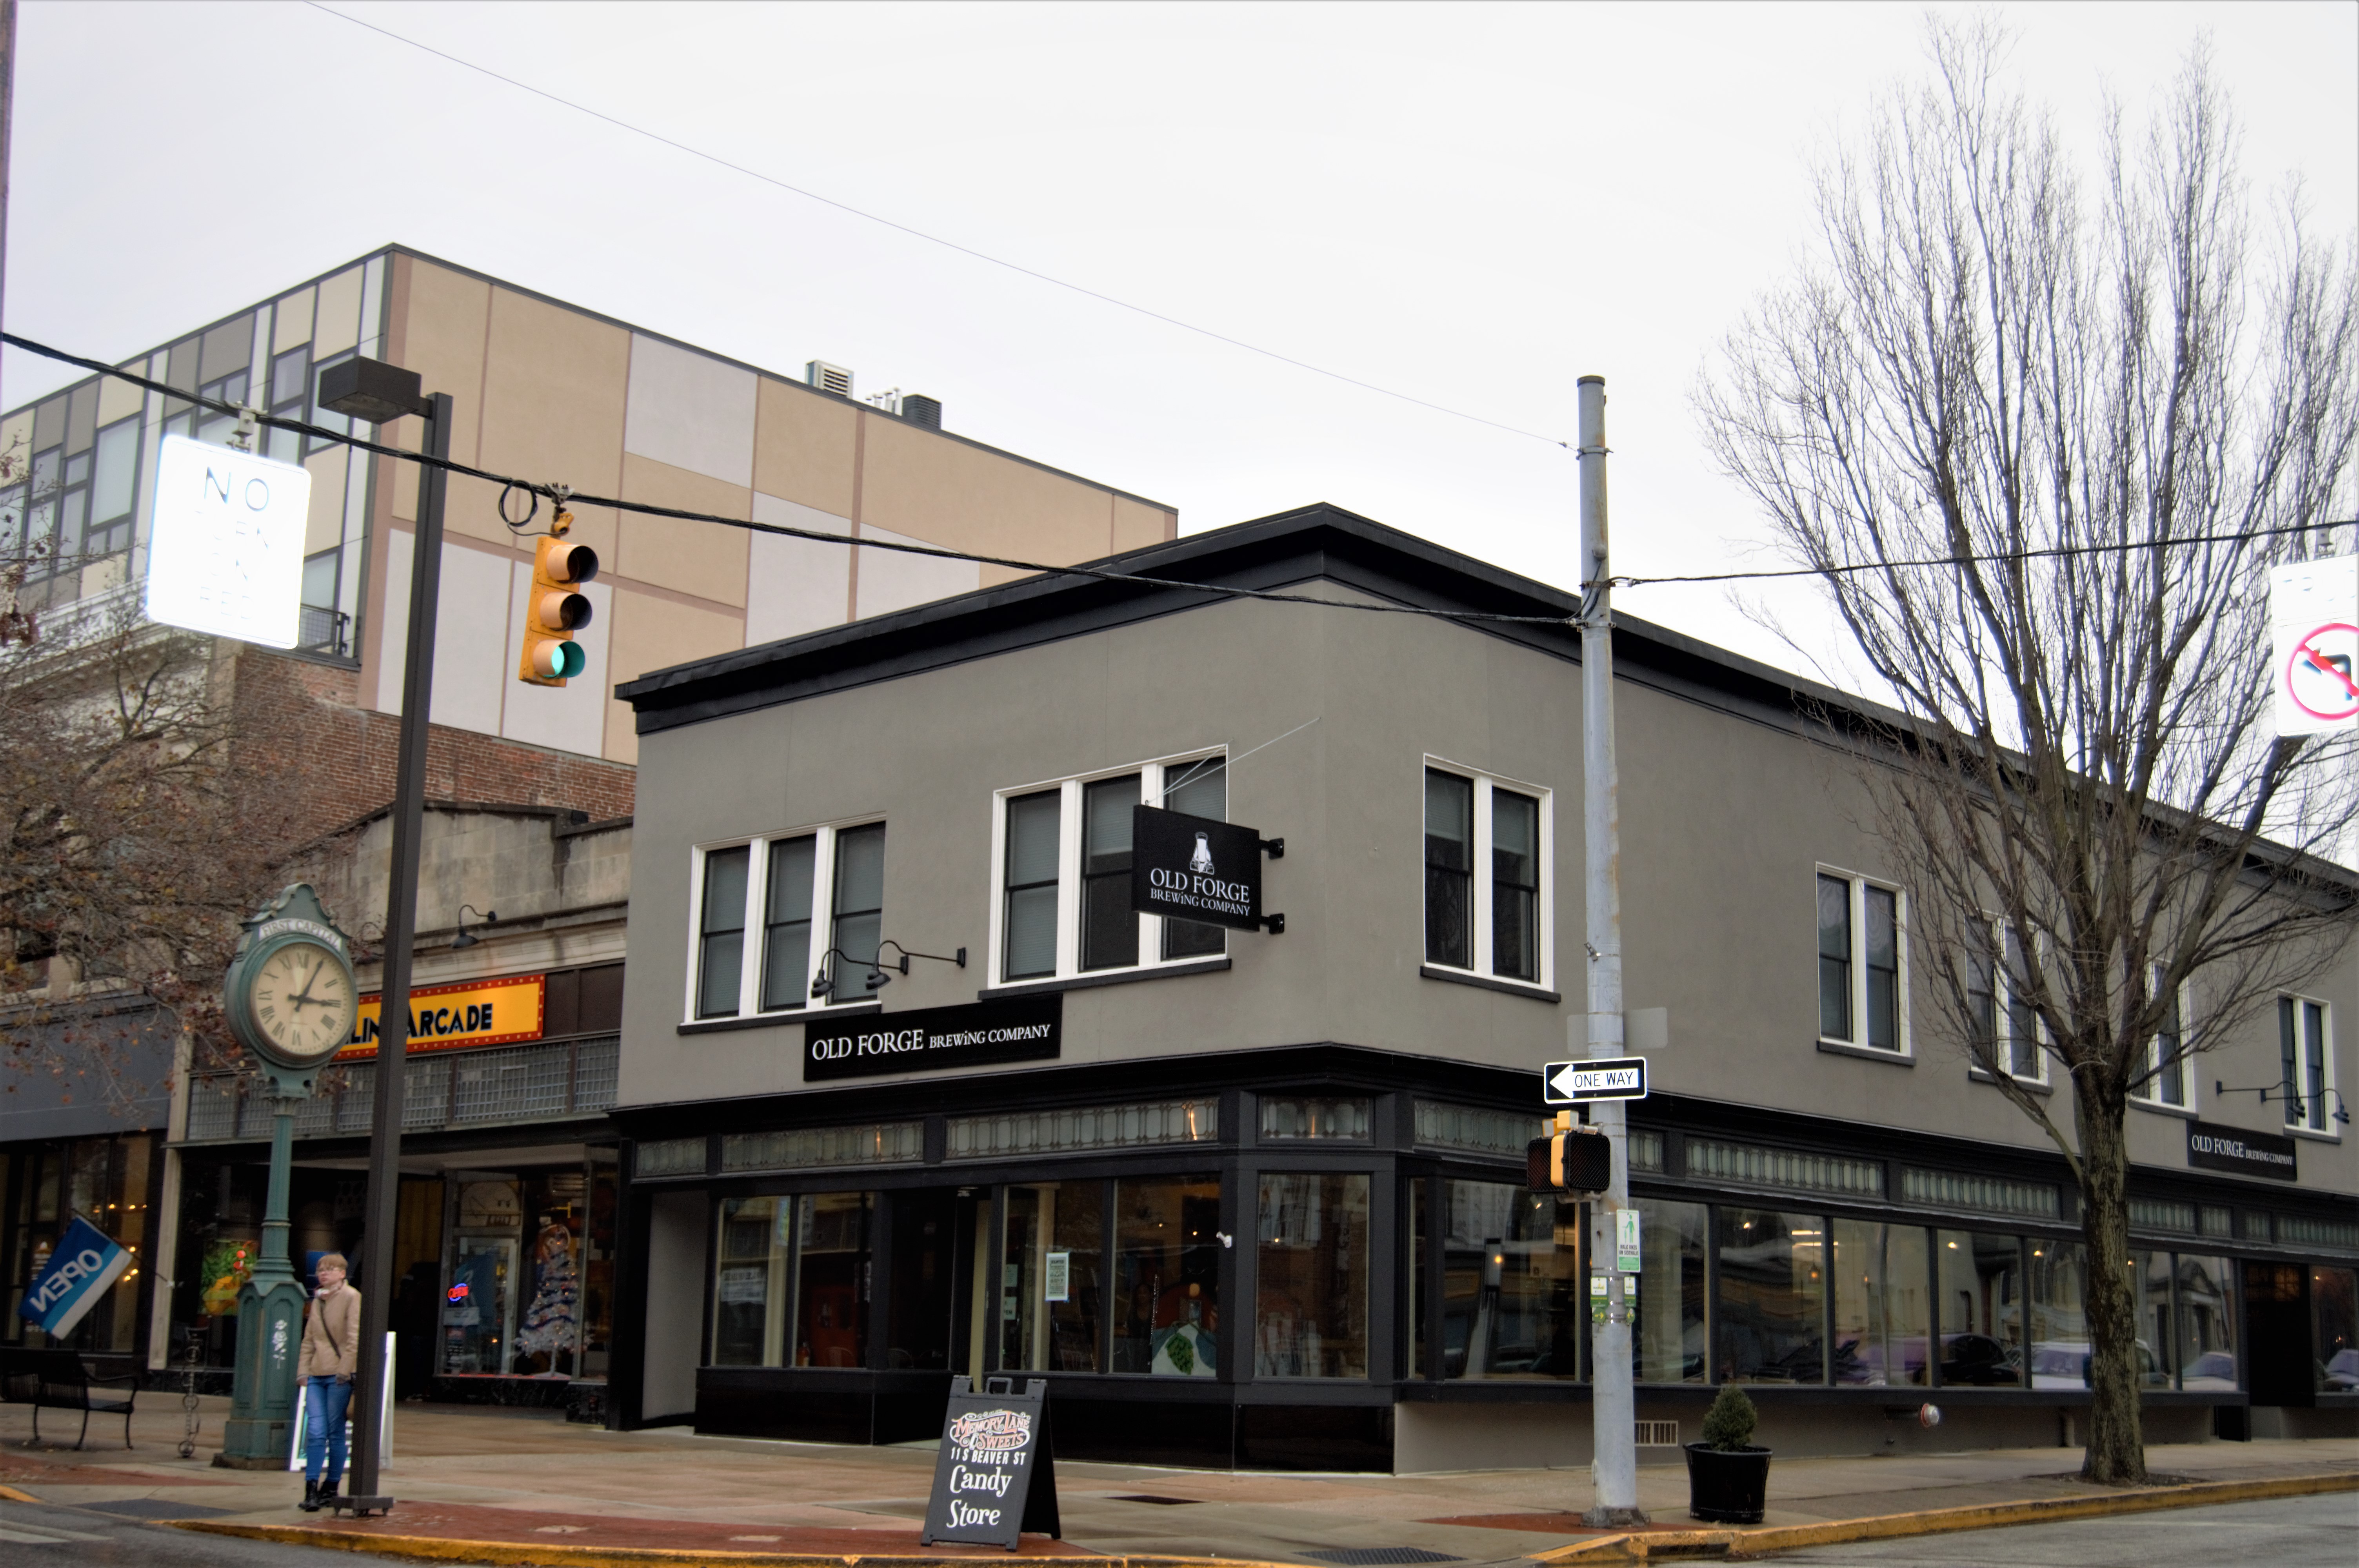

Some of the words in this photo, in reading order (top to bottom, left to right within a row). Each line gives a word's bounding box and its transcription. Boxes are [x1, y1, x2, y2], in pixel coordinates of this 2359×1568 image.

[204, 466, 270, 512] NO
[1150, 868, 1188, 891] OLD
[1193, 876, 1249, 903] FORGE
[1201, 897, 1250, 916] COMPANY
[263, 920, 290, 936] FIRST
[296, 921, 341, 949] CAPITAL
[407, 1003, 493, 1038] ARCADE
[812, 1036, 852, 1060] OLD
[858, 1029, 924, 1056] FORGE
[988, 1024, 1050, 1043] COMPANY
[1575, 1073, 1601, 1087] ONE
[1606, 1071, 1634, 1085] WAY
[2192, 1134, 2212, 1152] OLD
[2214, 1138, 2244, 1158] FORGE
[2269, 1153, 2293, 1165] COMPANY
[951, 1416, 1003, 1437] MEMORY
[1002, 1410, 1030, 1434] LANE
[978, 1433, 1025, 1450] SWEETS
[951, 1447, 960, 1460] 11
[962, 1450, 969, 1461] S
[972, 1450, 1009, 1465] BEAVER
[1013, 1452, 1026, 1466] ST
[950, 1465, 1012, 1497] Candy
[946, 1499, 1001, 1528] Store
